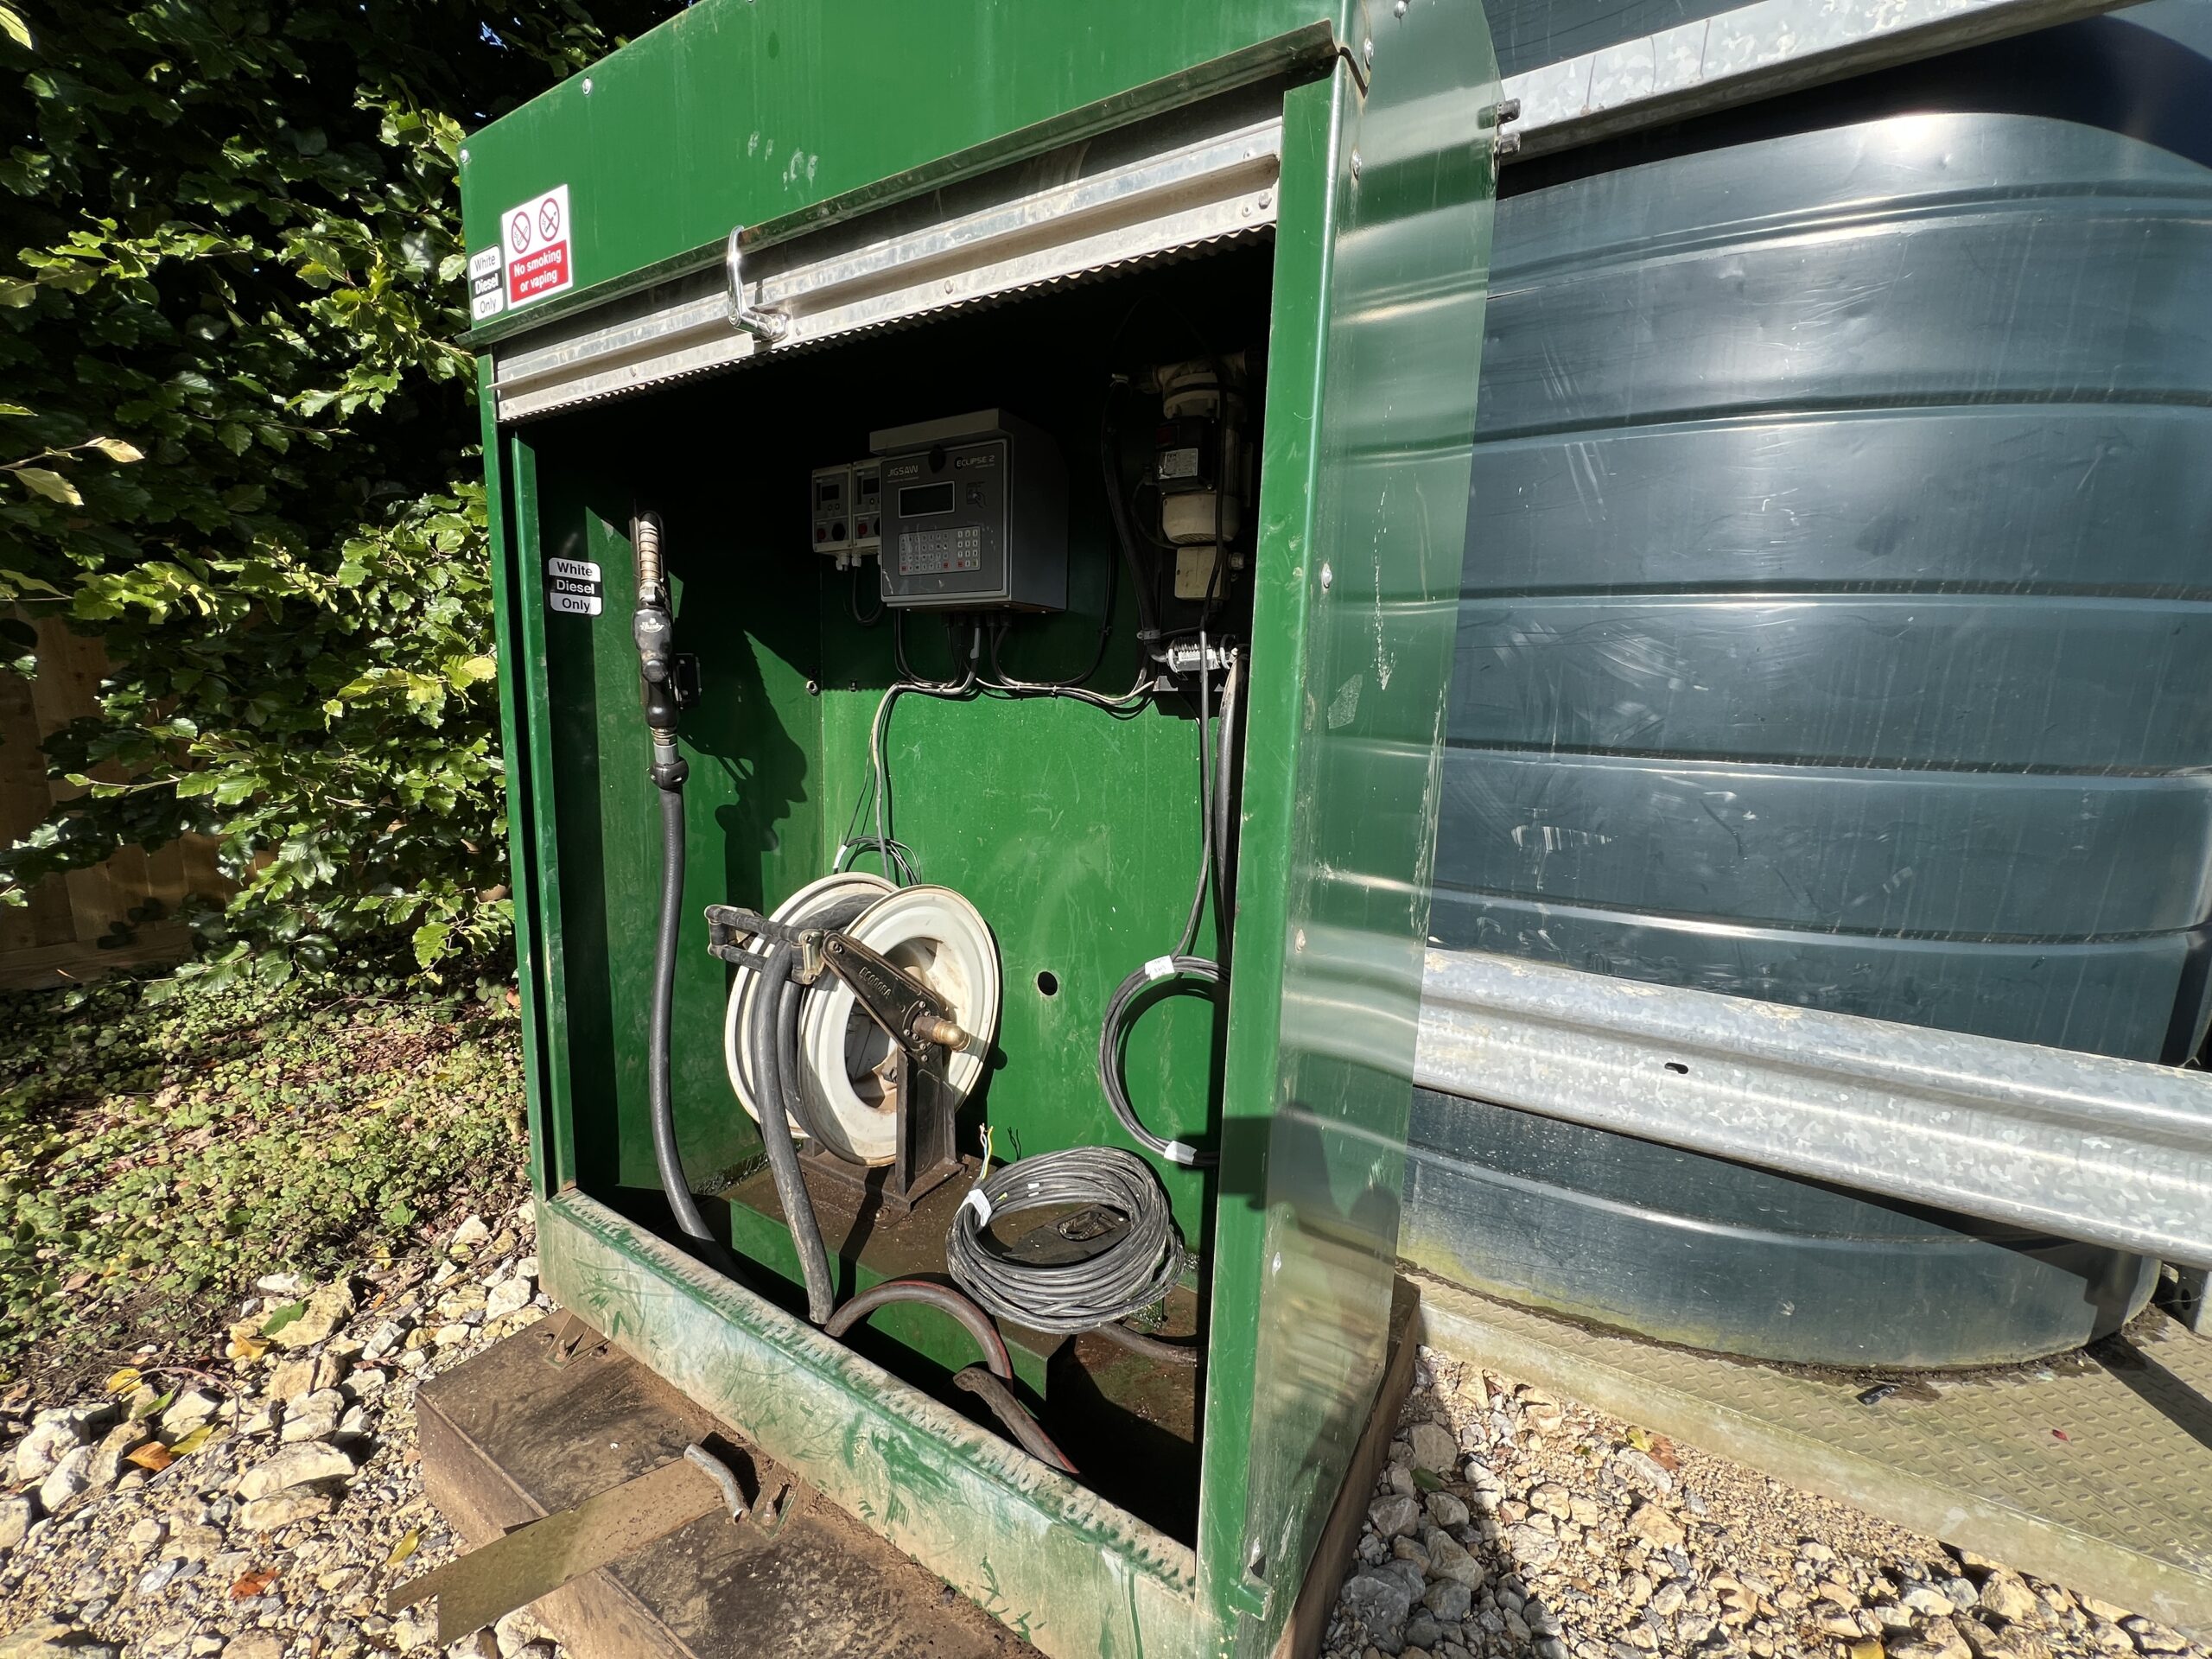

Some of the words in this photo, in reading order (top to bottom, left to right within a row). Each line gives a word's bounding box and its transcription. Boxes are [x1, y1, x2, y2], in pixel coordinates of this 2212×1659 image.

[474, 254, 496, 271] White
[514, 263, 525, 277] No
[527, 249, 562, 270] smoking
[474, 273, 499, 295] Diesel
[520, 281, 529, 292] or
[530, 270, 557, 289] vaping
[480, 298, 497, 314] Only
[957, 456, 987, 467] ECLIPSE
[887, 465, 918, 477] JIGSAW
[556, 562, 593, 576] White
[556, 579, 594, 594] Diesel
[562, 598, 590, 613] Only
[858, 966, 893, 997] ECODORA
